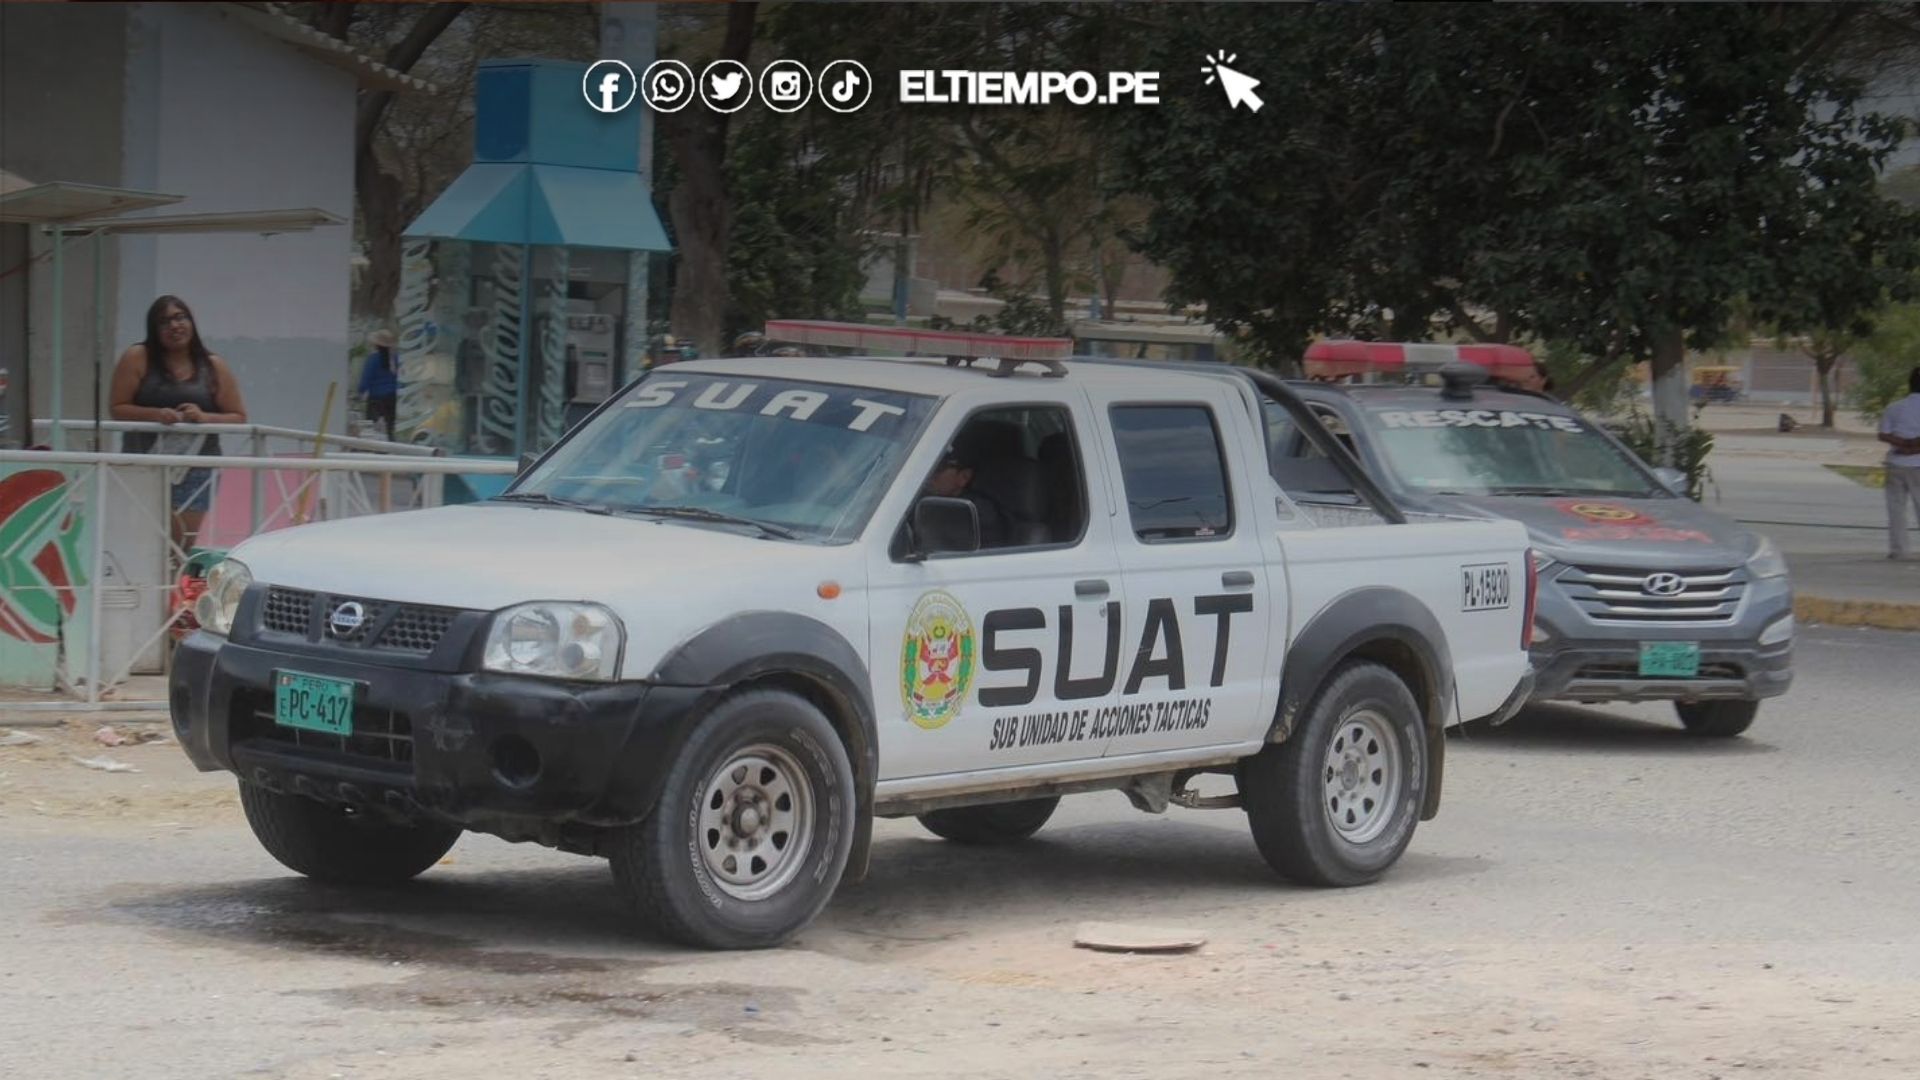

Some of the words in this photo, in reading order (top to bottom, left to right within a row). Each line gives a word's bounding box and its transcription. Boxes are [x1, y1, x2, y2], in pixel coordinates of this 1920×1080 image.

[624, 381, 906, 432] SUAT
[1378, 410, 1584, 434] RESCATE
[1463, 568, 1509, 607] PL-15930
[978, 593, 1254, 708] SUAT
[990, 714, 1018, 750] SUB
[1019, 710, 1068, 746] UNIDAD
[1069, 708, 1087, 742] DE
[1089, 703, 1151, 740] ACCIONES
[1153, 699, 1212, 732] TACTICAS
